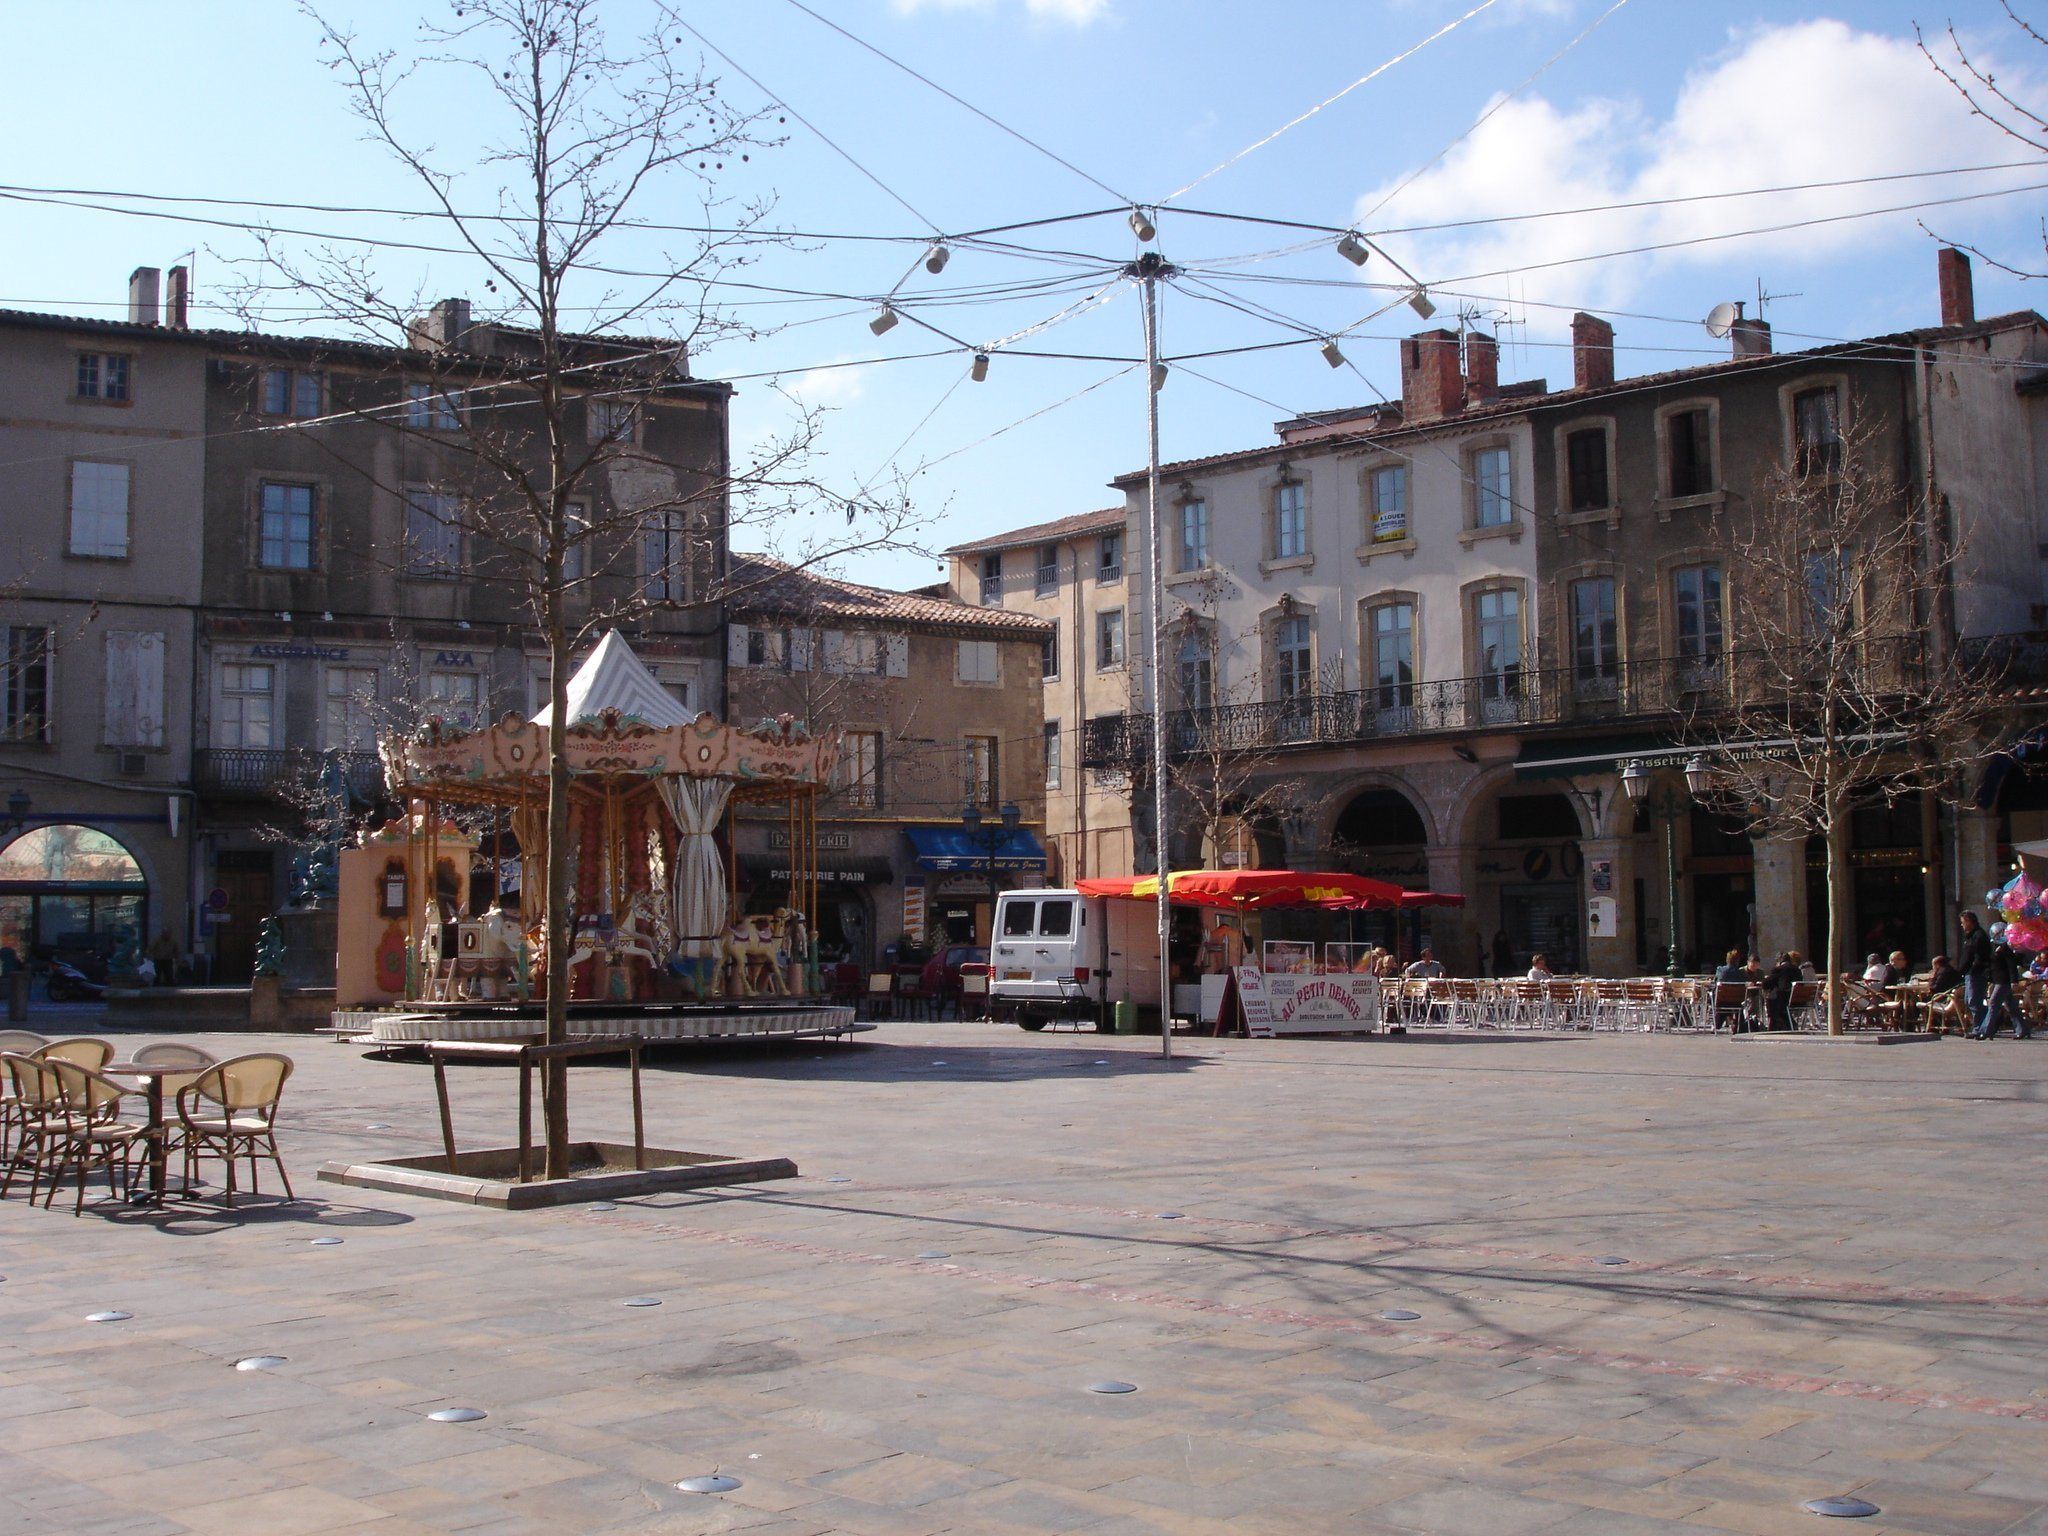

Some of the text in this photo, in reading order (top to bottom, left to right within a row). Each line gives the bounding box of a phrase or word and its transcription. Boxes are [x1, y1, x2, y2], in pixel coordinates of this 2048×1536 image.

[250, 644, 475, 668] ASSURANCE AXA
[1615, 754, 1688, 770] Bsserie
[840, 871, 865, 882] PAIN
[1281, 998, 1296, 1022] AU
[1296, 981, 1326, 1006] PETIT
